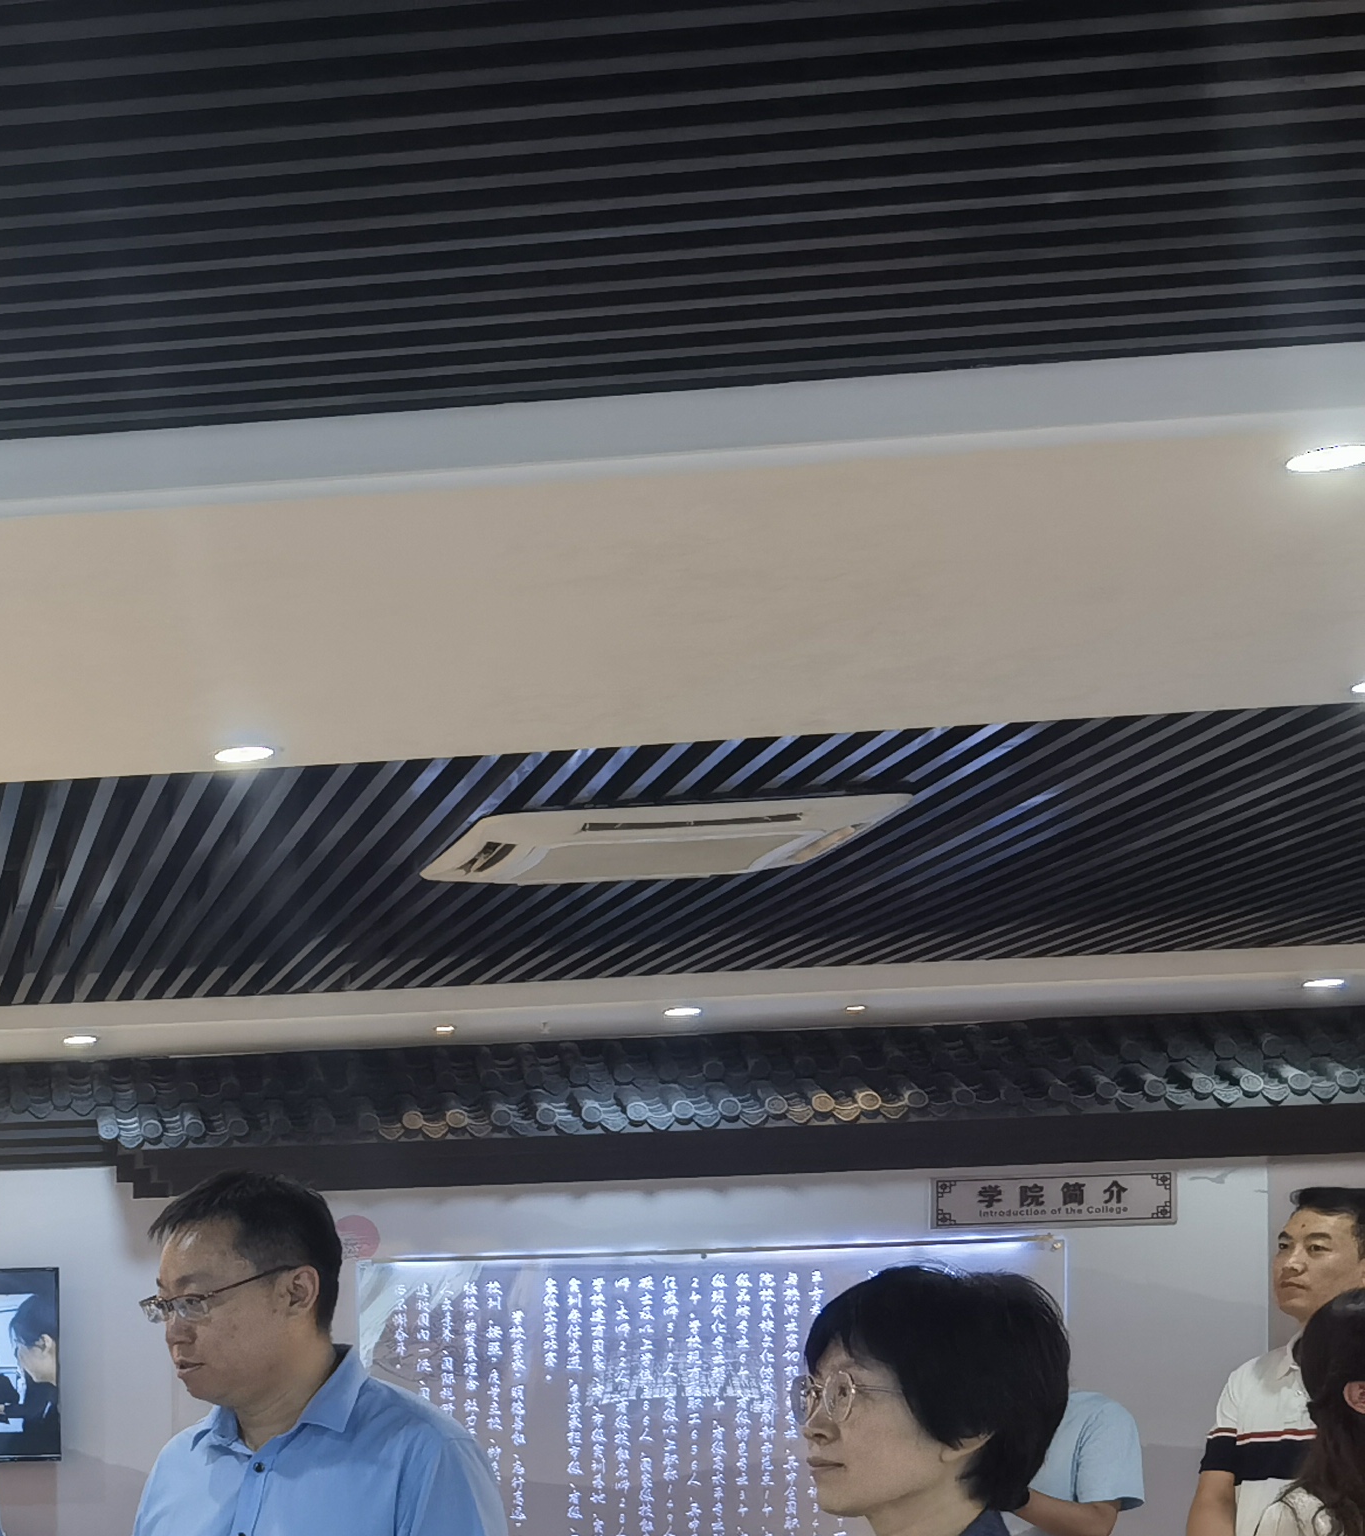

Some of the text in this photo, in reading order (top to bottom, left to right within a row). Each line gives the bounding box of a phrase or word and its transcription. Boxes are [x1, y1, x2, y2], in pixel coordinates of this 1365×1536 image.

[977, 1180, 1129, 1208] 学院简介
[979, 1204, 1129, 1219] Introduction of the College
